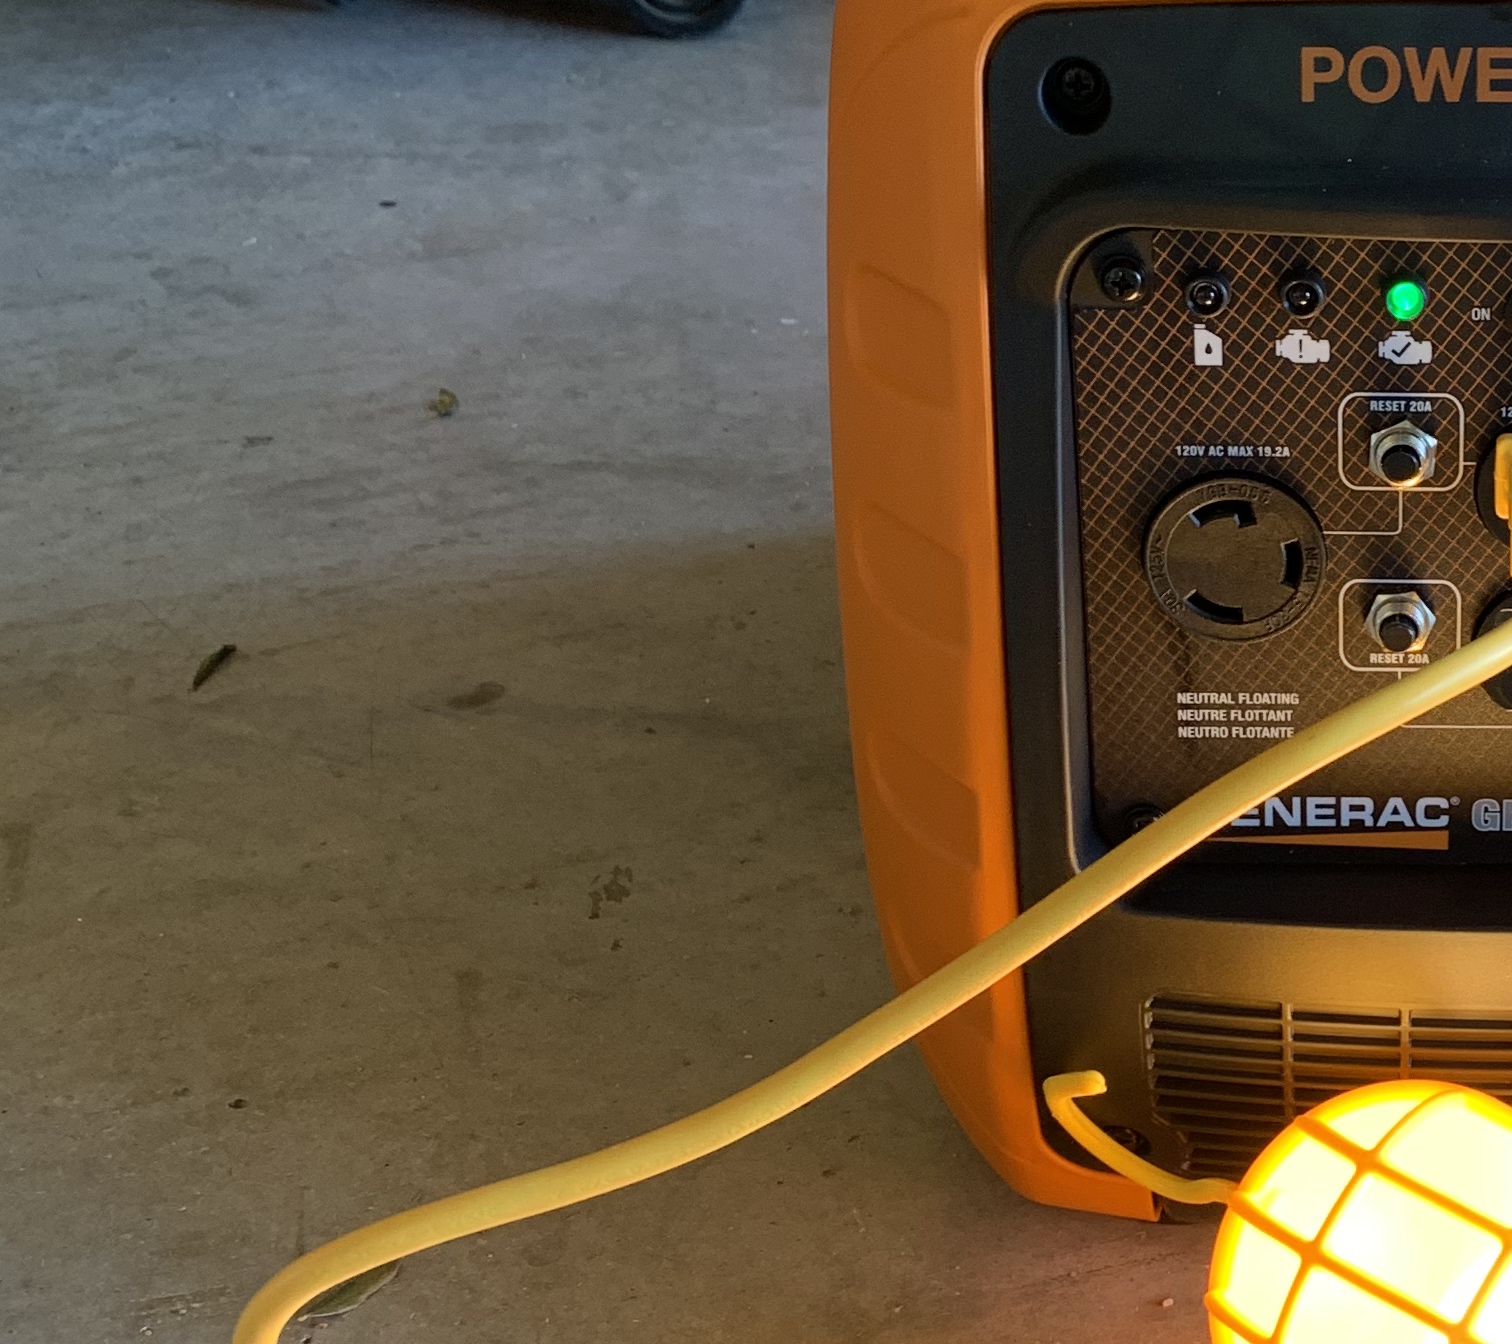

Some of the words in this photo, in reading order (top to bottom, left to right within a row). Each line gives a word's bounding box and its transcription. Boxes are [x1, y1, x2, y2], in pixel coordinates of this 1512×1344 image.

[1471, 307, 1491, 322] ON
[1369, 400, 1406, 413] RESET
[1409, 400, 1432, 413] 20A
[1175, 445, 1205, 457] 120V
[1207, 445, 1224, 457] AC
[1227, 445, 1254, 457] MAX
[1256, 445, 1291, 457] 19.2A
[1369, 652, 1404, 665] RESET
[1407, 652, 1430, 665] 20A
[1176, 692, 1235, 705] NEUTRAL
[1237, 692, 1300, 705] FLOATING
[1177, 709, 1228, 722] NEUTRE
[1230, 709, 1294, 722] FLOTTANT
[1177, 726, 1229, 739] NEUTRO
[1231, 726, 1295, 739] FLOTANTE
